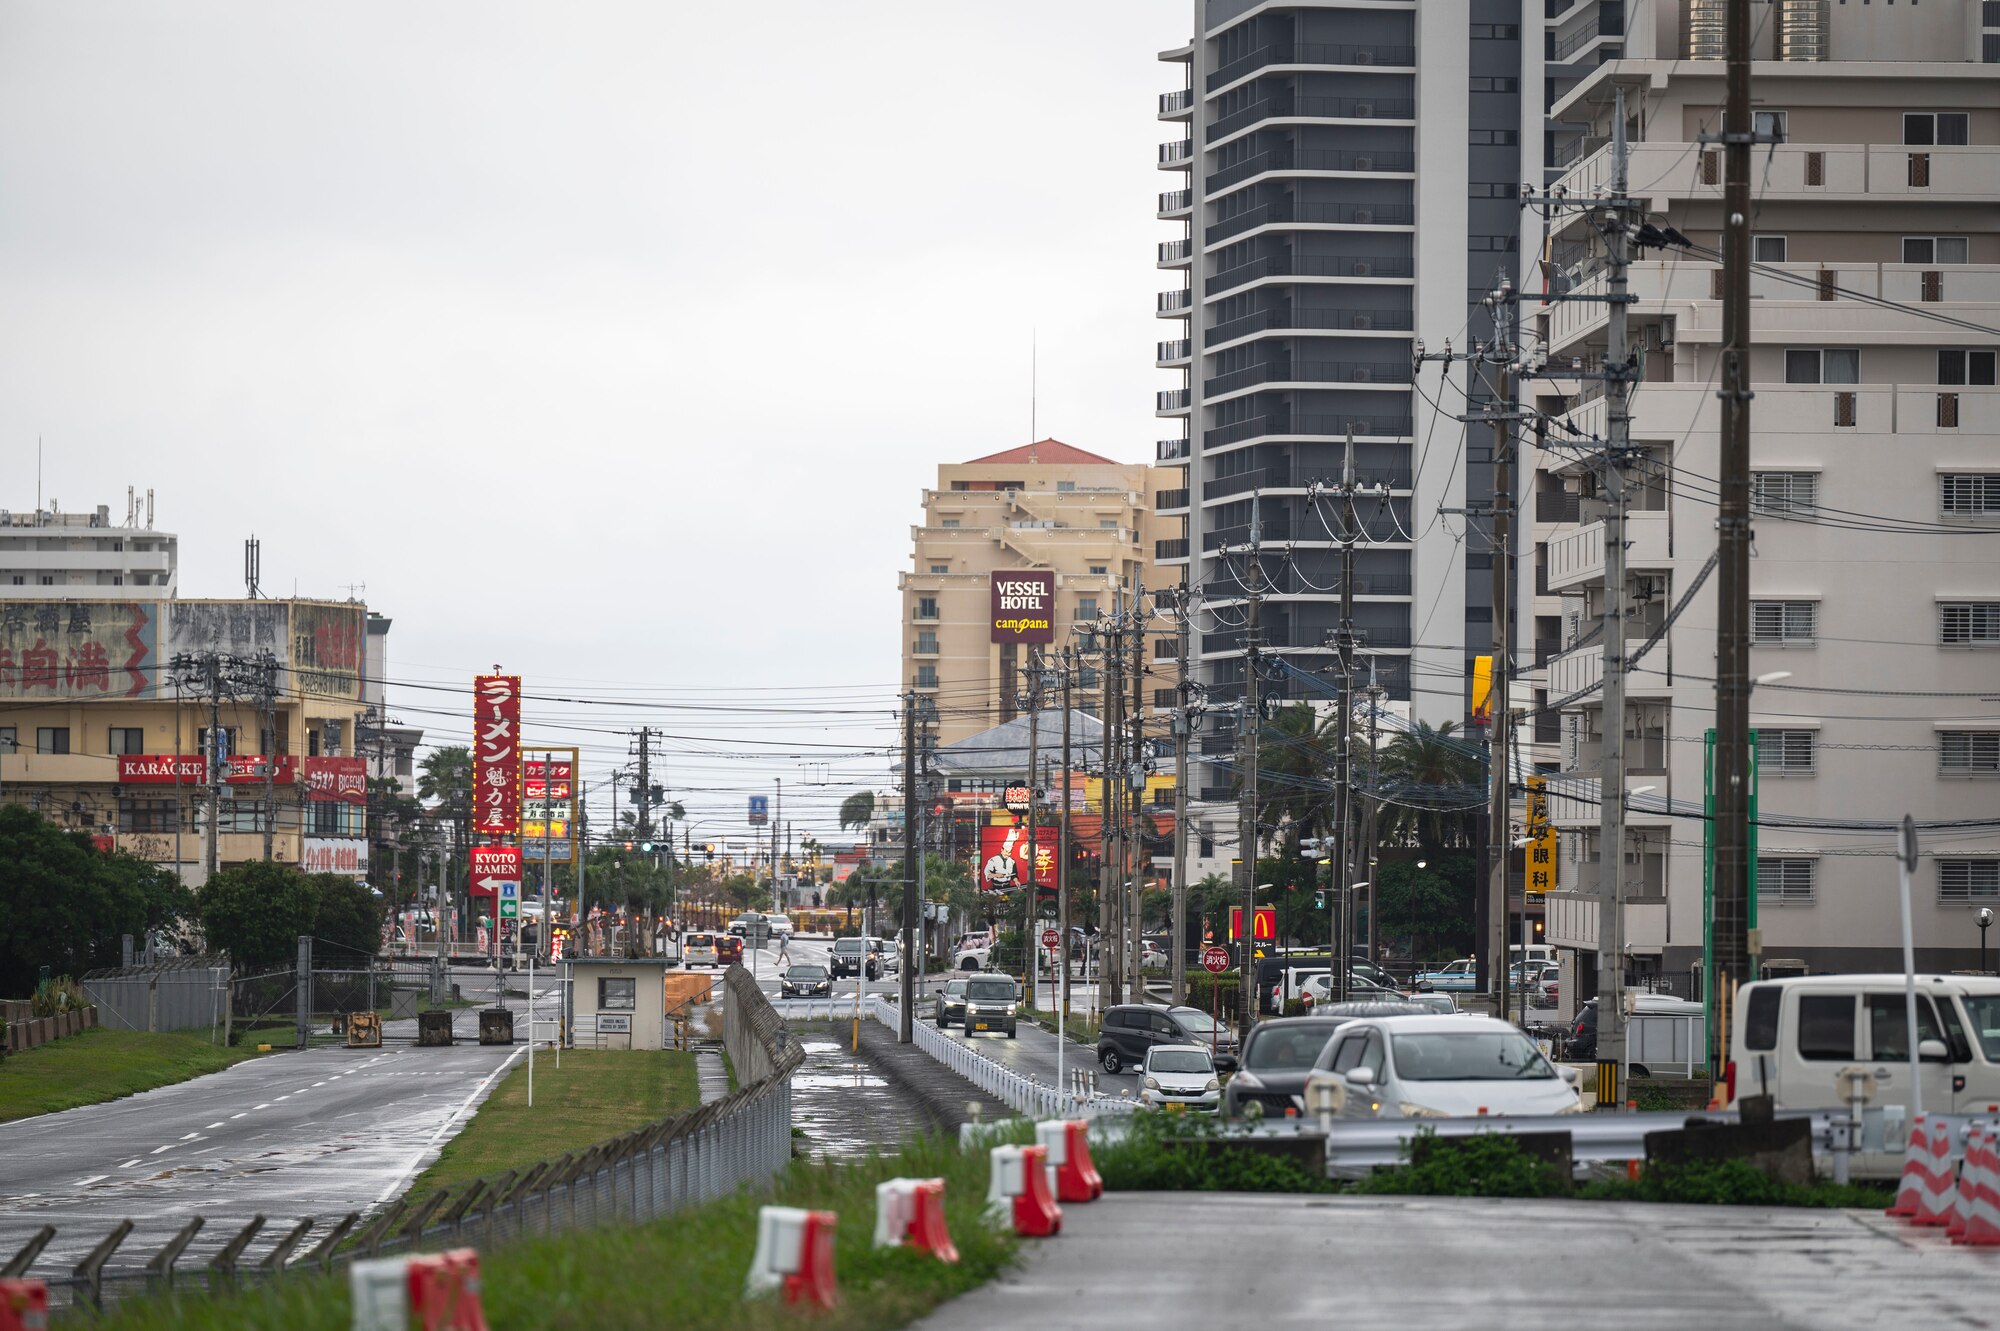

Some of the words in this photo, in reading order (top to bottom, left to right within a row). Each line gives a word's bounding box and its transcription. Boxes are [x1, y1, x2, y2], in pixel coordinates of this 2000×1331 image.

[996, 581, 1049, 596] VESSEL
[1000, 596, 1043, 609] HOTEL
[995, 618, 1049, 634] campana
[481, 680, 512, 763] ラーメン
[125, 762, 203, 776] KARAOKE
[526, 765, 569, 776] カラオケ
[310, 770, 335, 790] カラオケ
[338, 774, 350, 793] BIG
[349, 774, 366, 793] ECHO
[482, 766, 507, 827] 魁力屋
[475, 853, 516, 863] KYOTO
[475, 864, 517, 874] RAMEN
[1205, 955, 1227, 965] 消火栓
